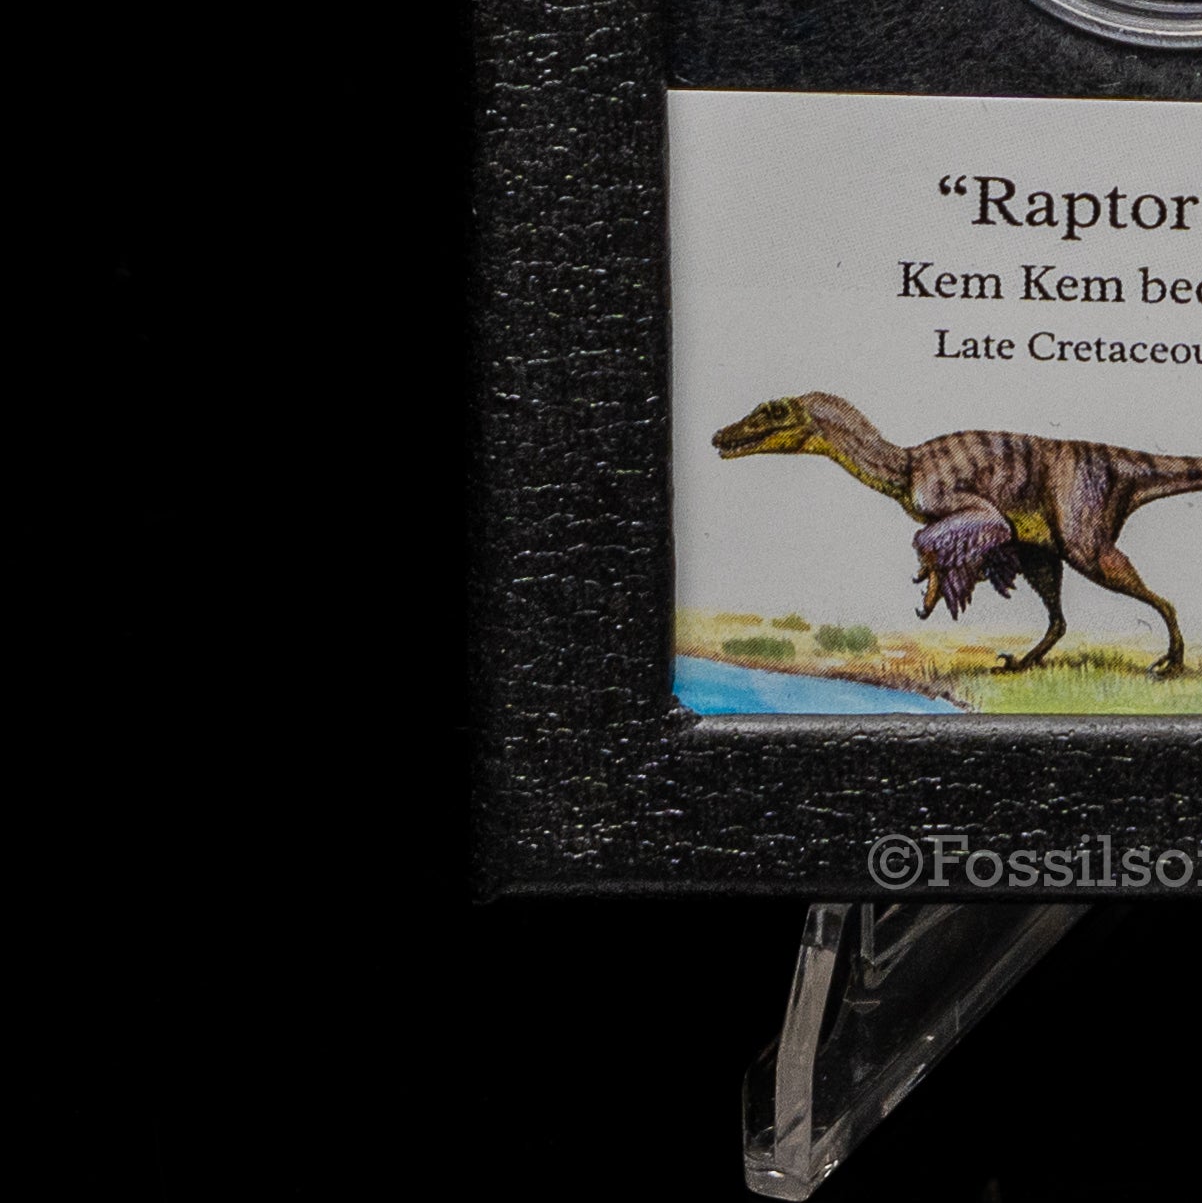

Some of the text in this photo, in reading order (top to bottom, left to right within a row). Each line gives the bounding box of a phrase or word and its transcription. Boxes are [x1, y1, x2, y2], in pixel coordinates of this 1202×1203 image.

[897, 260, 1004, 300] Kem
[1019, 264, 1126, 303] Kem
[933, 328, 1016, 361] Late
